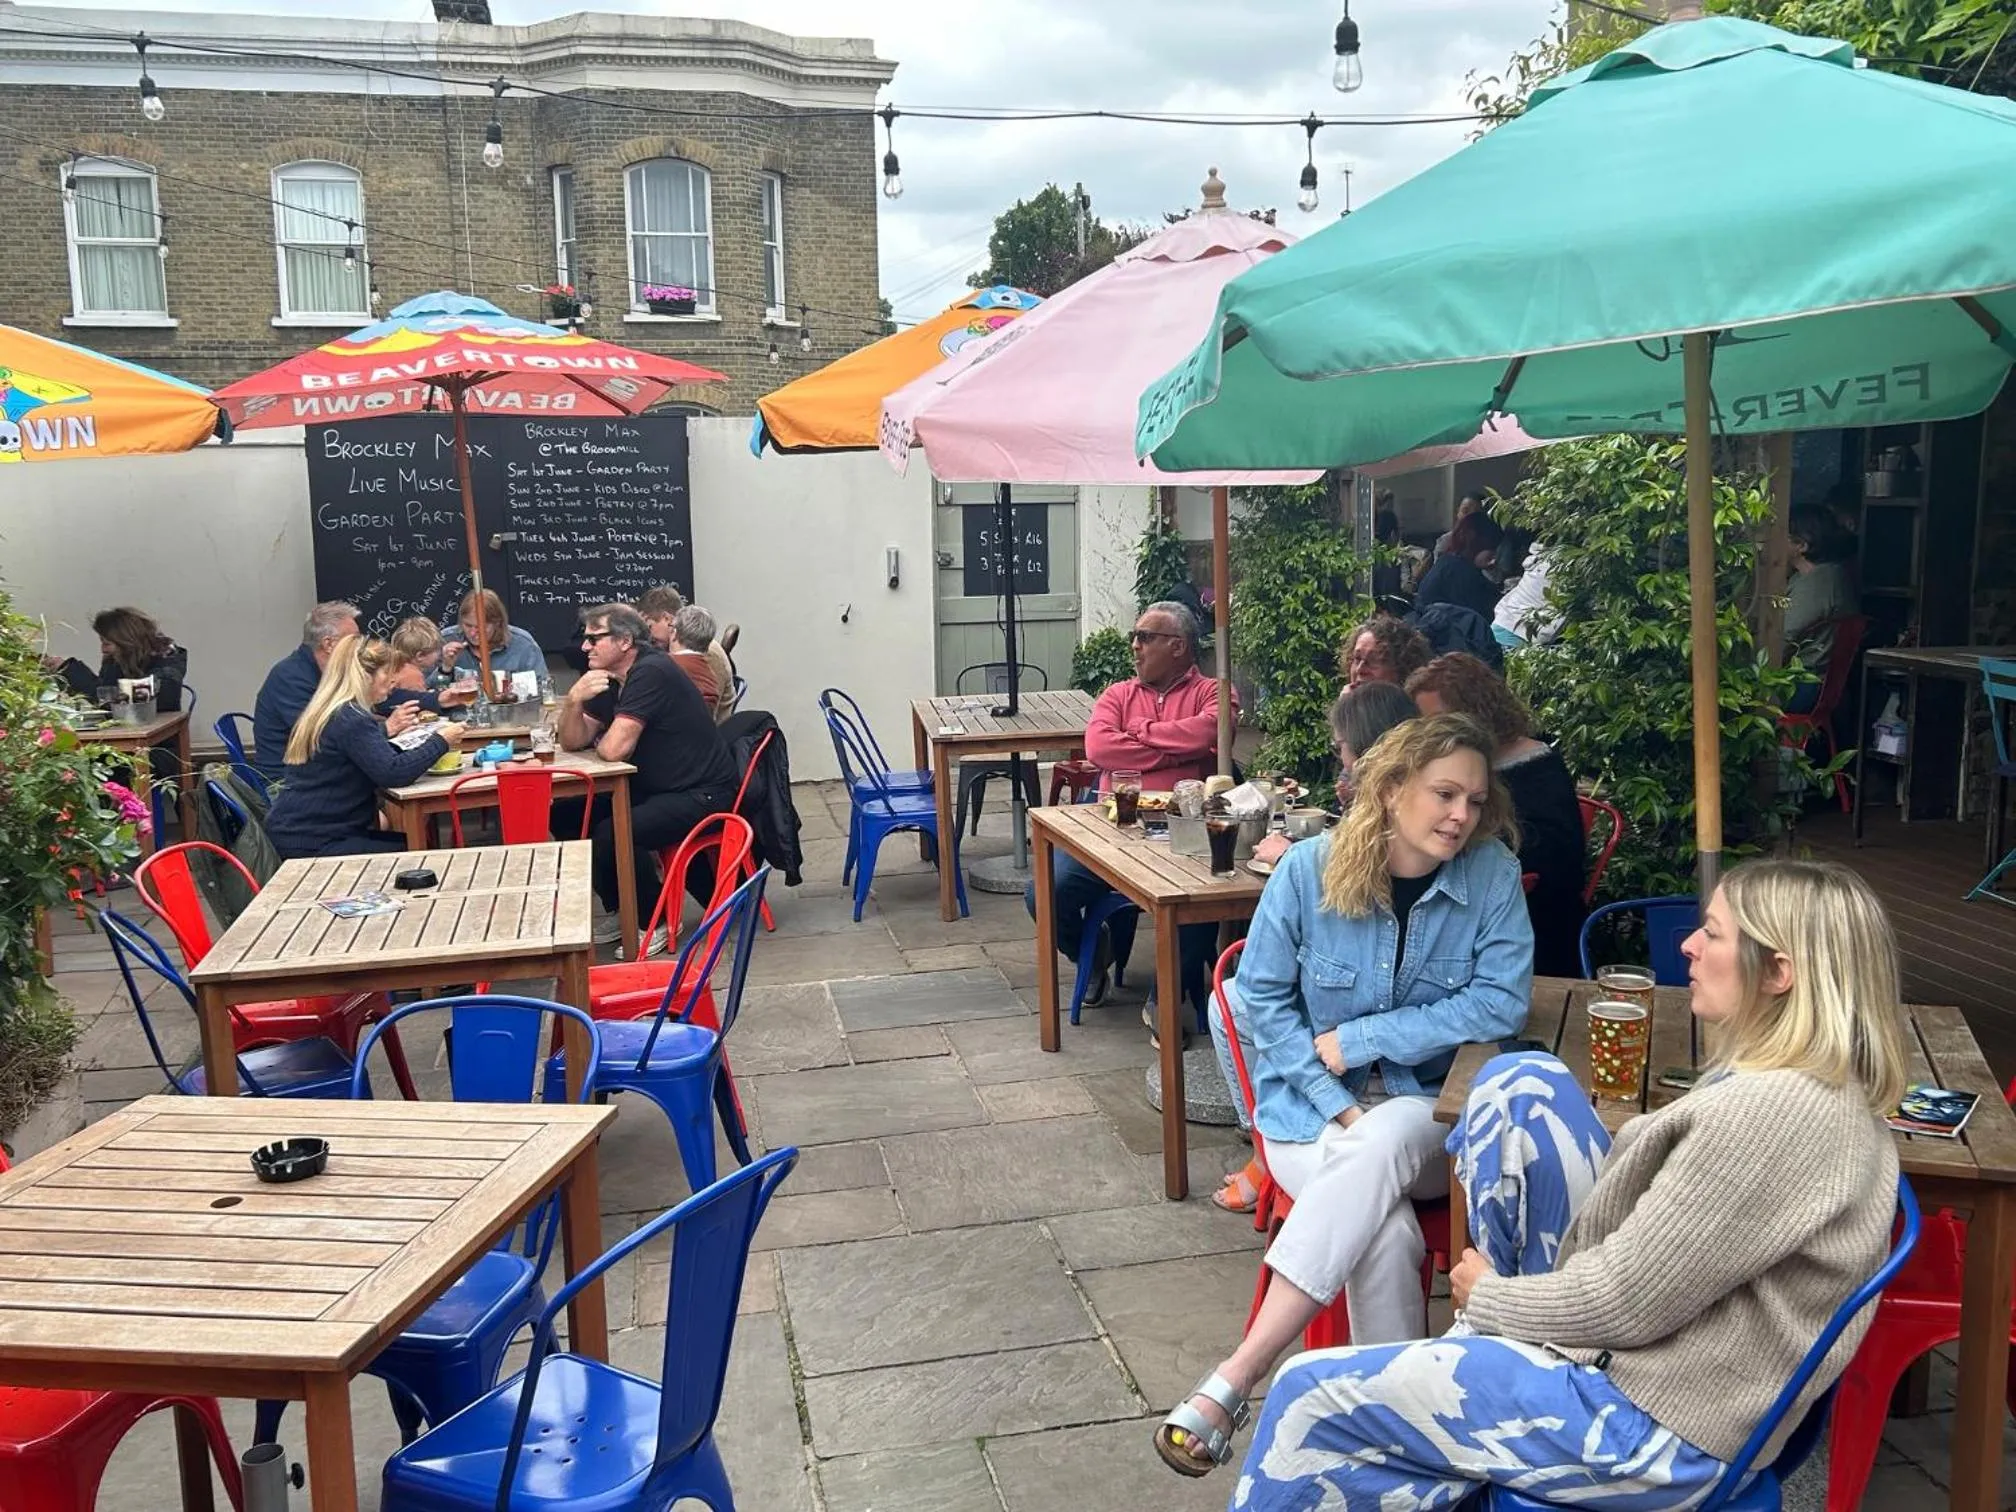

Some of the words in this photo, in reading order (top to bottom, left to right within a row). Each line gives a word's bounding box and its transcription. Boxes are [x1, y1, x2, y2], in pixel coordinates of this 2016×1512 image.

[302, 349, 640, 389] BEAVERTOWN
[525, 422, 588, 439] BROCKLEY
[605, 423, 642, 438] MAX
[323, 429, 417, 460] BROCKLEY
[348, 467, 387, 494] LIVE
[399, 467, 461, 493] MUSIC
[587, 460, 632, 475] GARDEN
[636, 461, 670, 474] PARTY
[318, 503, 395, 530] GARDEN
